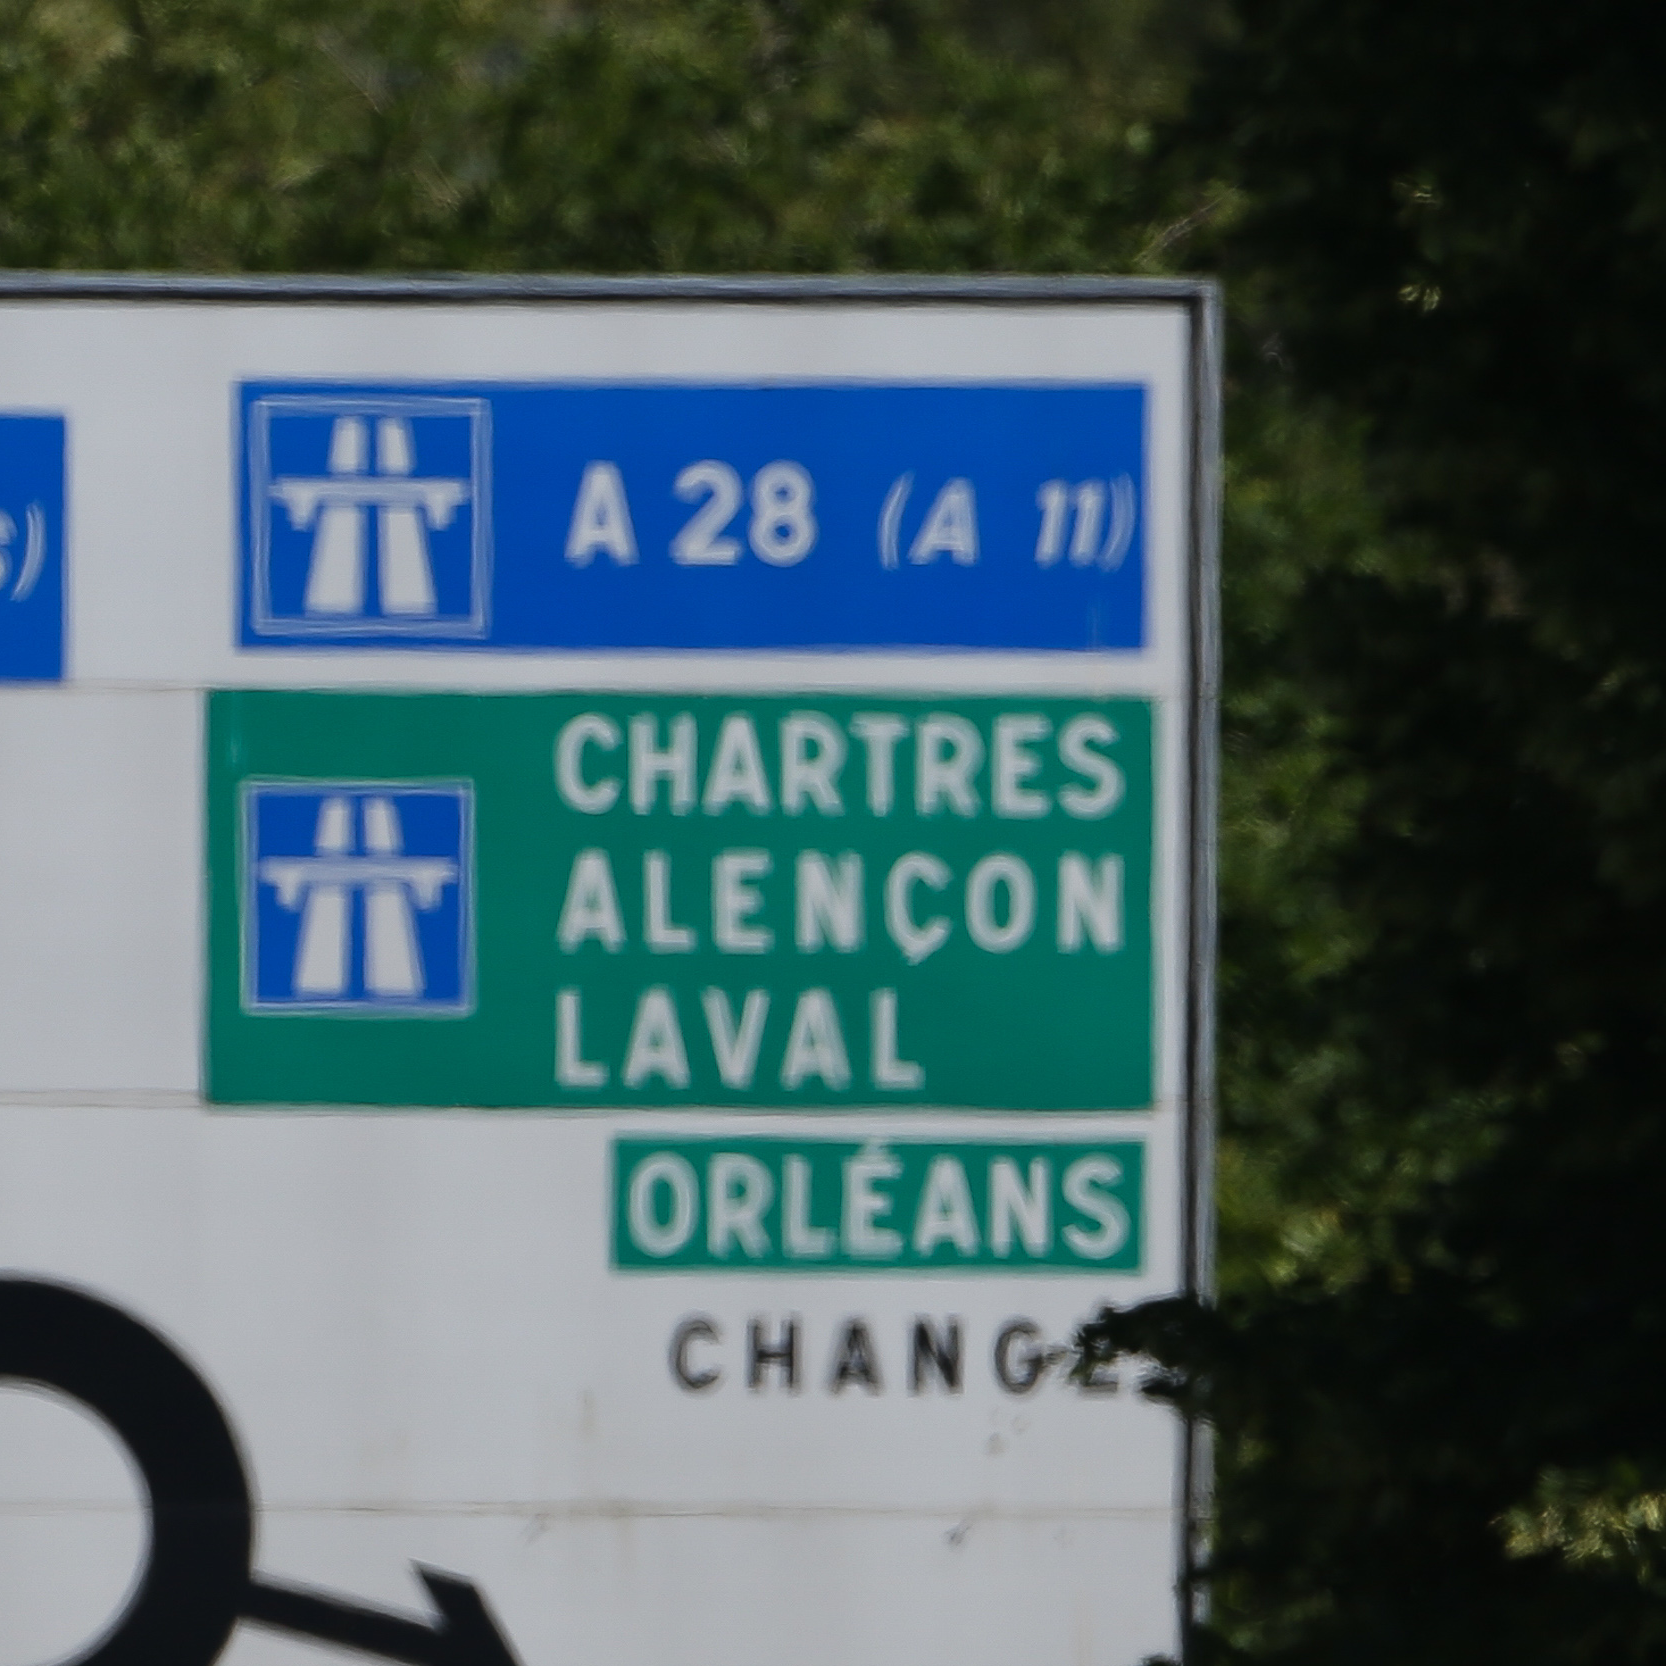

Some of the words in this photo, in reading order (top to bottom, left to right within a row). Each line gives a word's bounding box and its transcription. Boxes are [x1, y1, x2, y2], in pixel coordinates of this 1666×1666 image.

[564, 461, 638, 566] A
[670, 460, 819, 567] 28
[879, 471, 980, 571] (A
[555, 709, 1126, 818] CHARTRES
[556, 847, 1124, 964] ALENÇON
[555, 987, 926, 1091] LAVAL
[627, 1137, 1132, 1260] ORLÉANS
